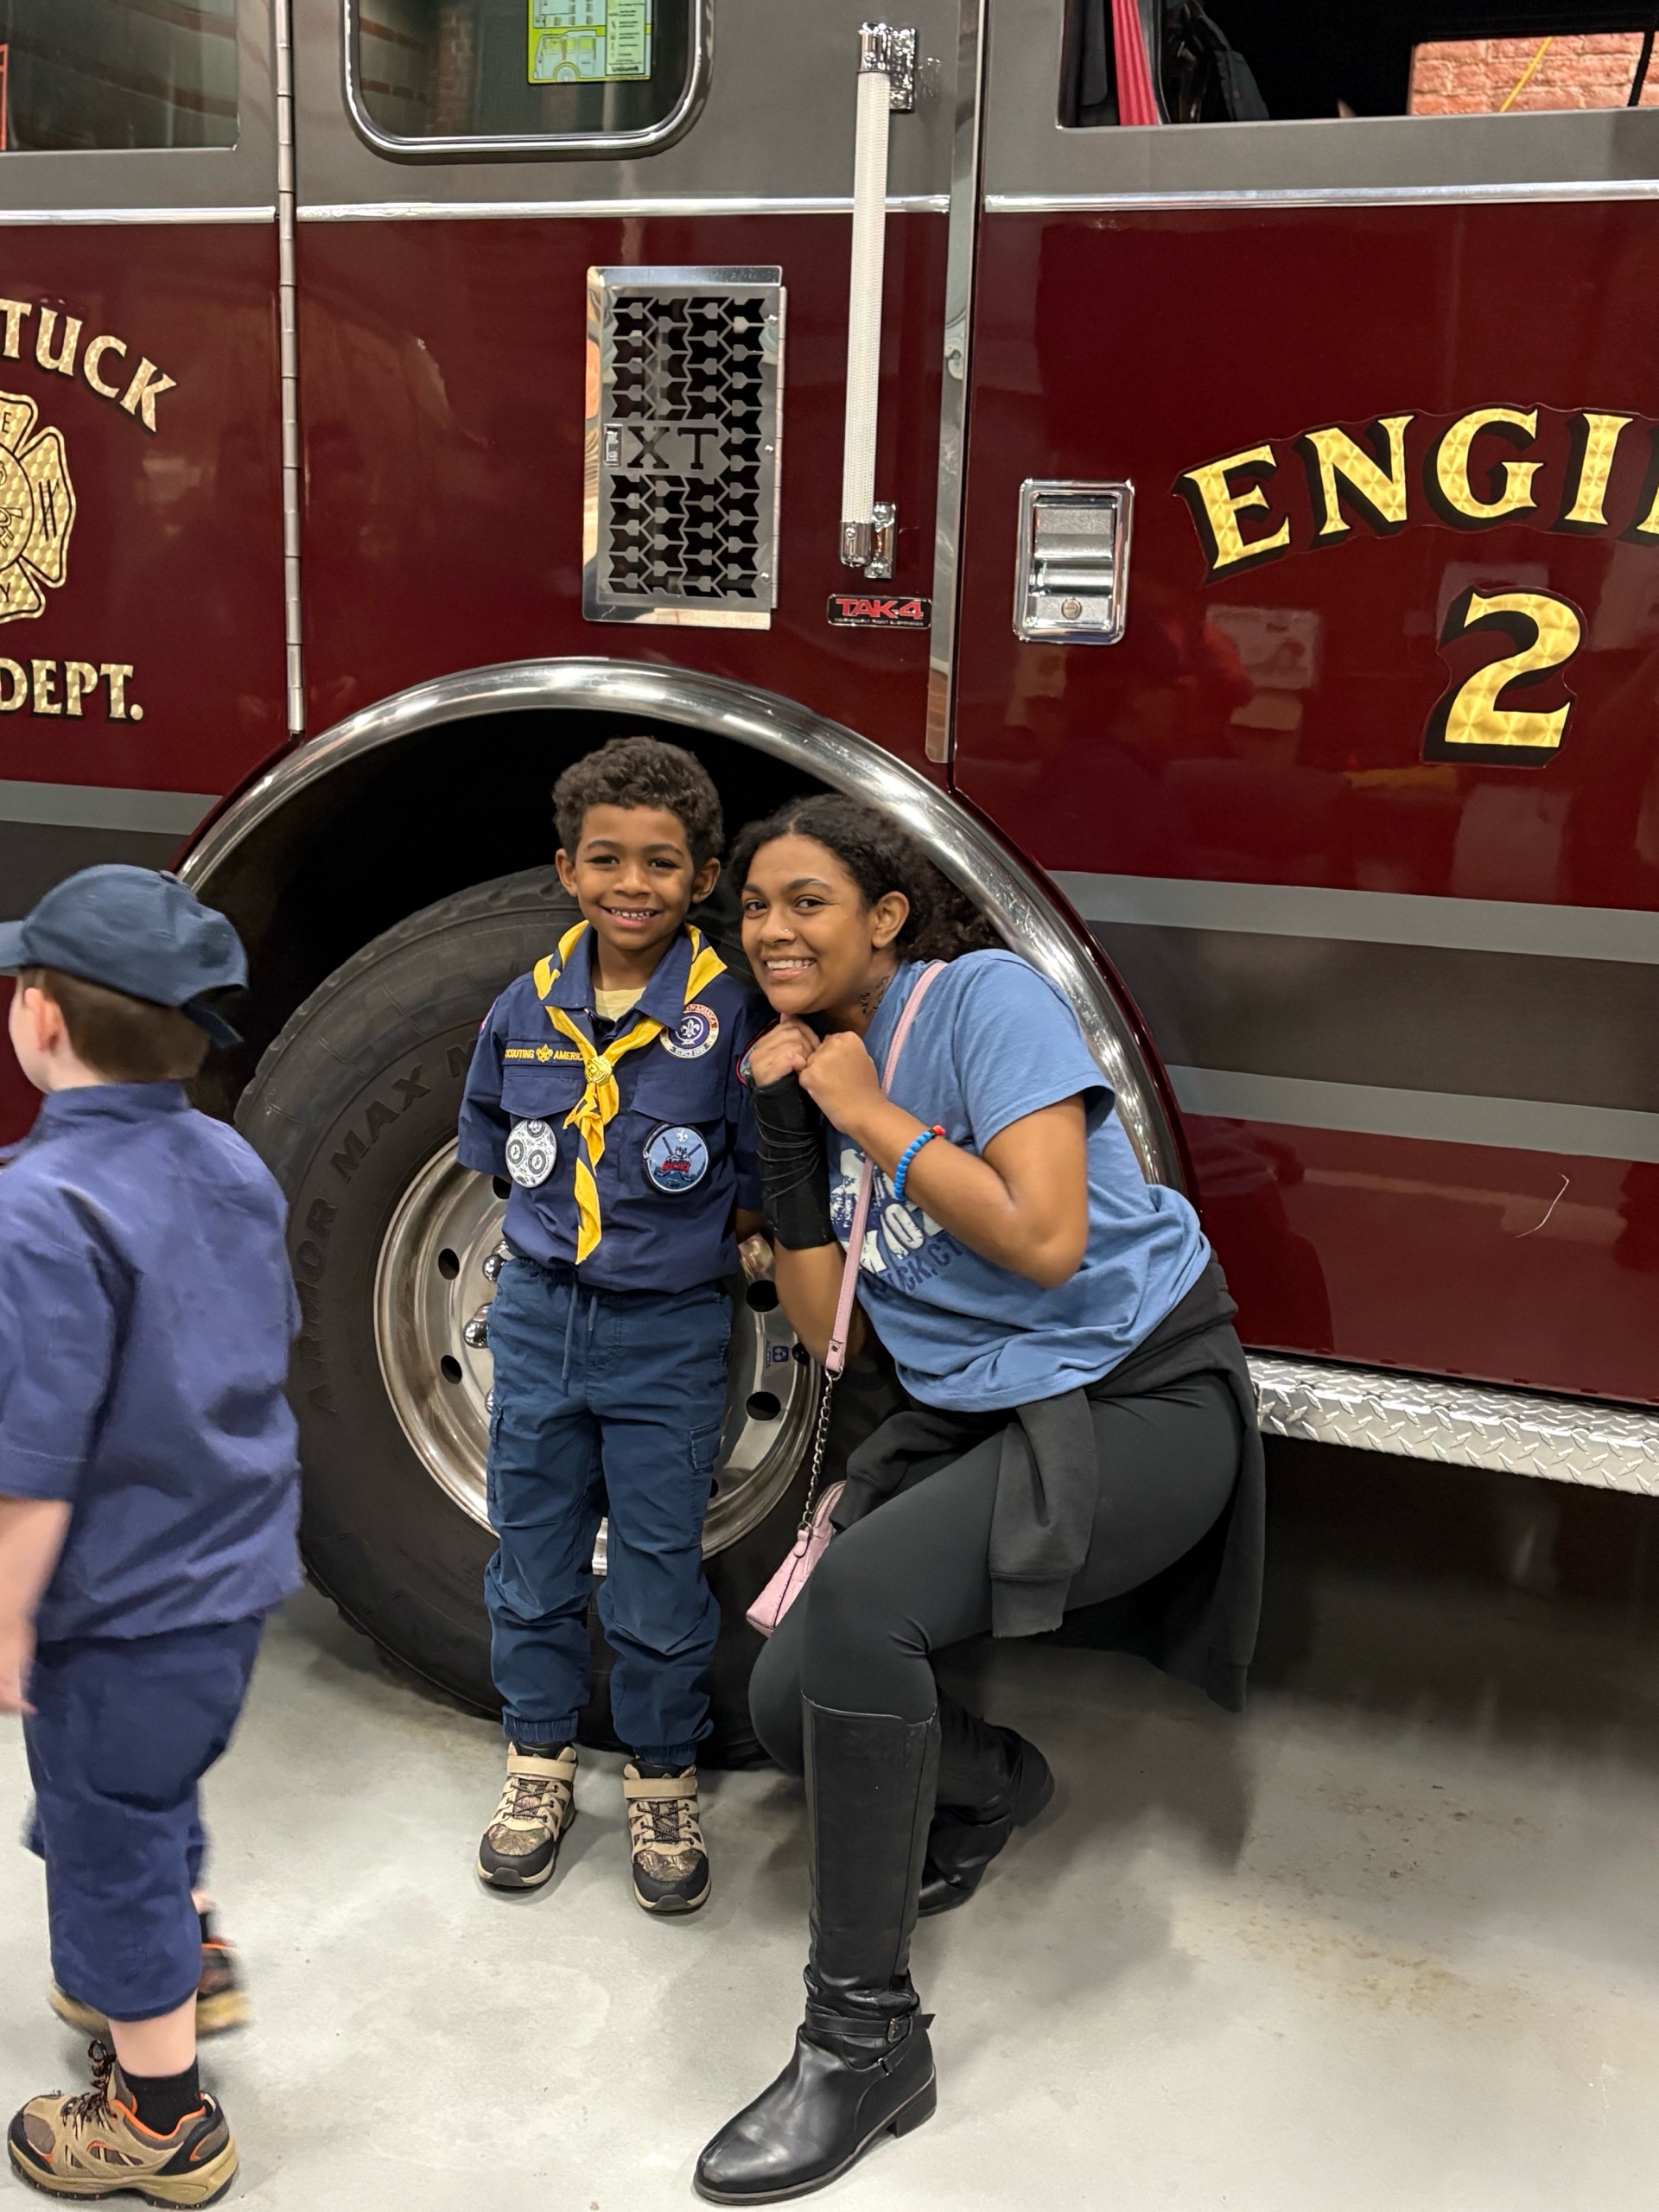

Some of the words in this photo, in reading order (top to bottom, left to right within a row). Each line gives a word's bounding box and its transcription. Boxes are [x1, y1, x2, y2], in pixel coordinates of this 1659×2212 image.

[627, 426, 719, 471] XT
[1182, 407, 1659, 569] ENGI
[1444, 593, 1581, 748] 2
[505, 1048, 535, 1060] SCOUTING
[553, 1050, 583, 1062] AMERIC
[331, 1065, 430, 1182] MAX
